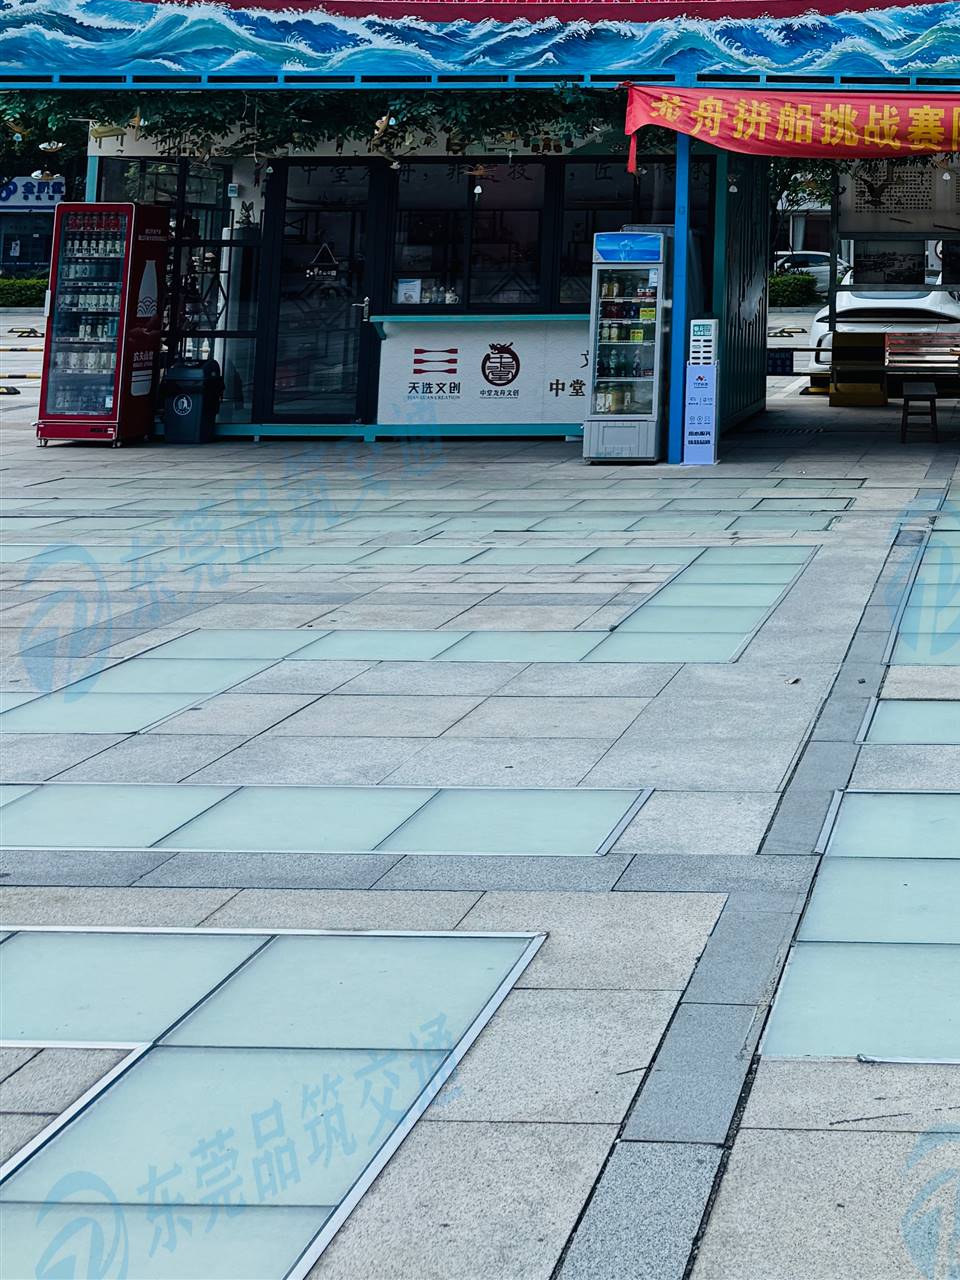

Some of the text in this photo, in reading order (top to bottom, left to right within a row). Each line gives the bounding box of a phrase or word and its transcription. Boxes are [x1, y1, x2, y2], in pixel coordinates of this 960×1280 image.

[408, 381, 461, 394] 天选文创
[549, 379, 586, 397] 中堂
